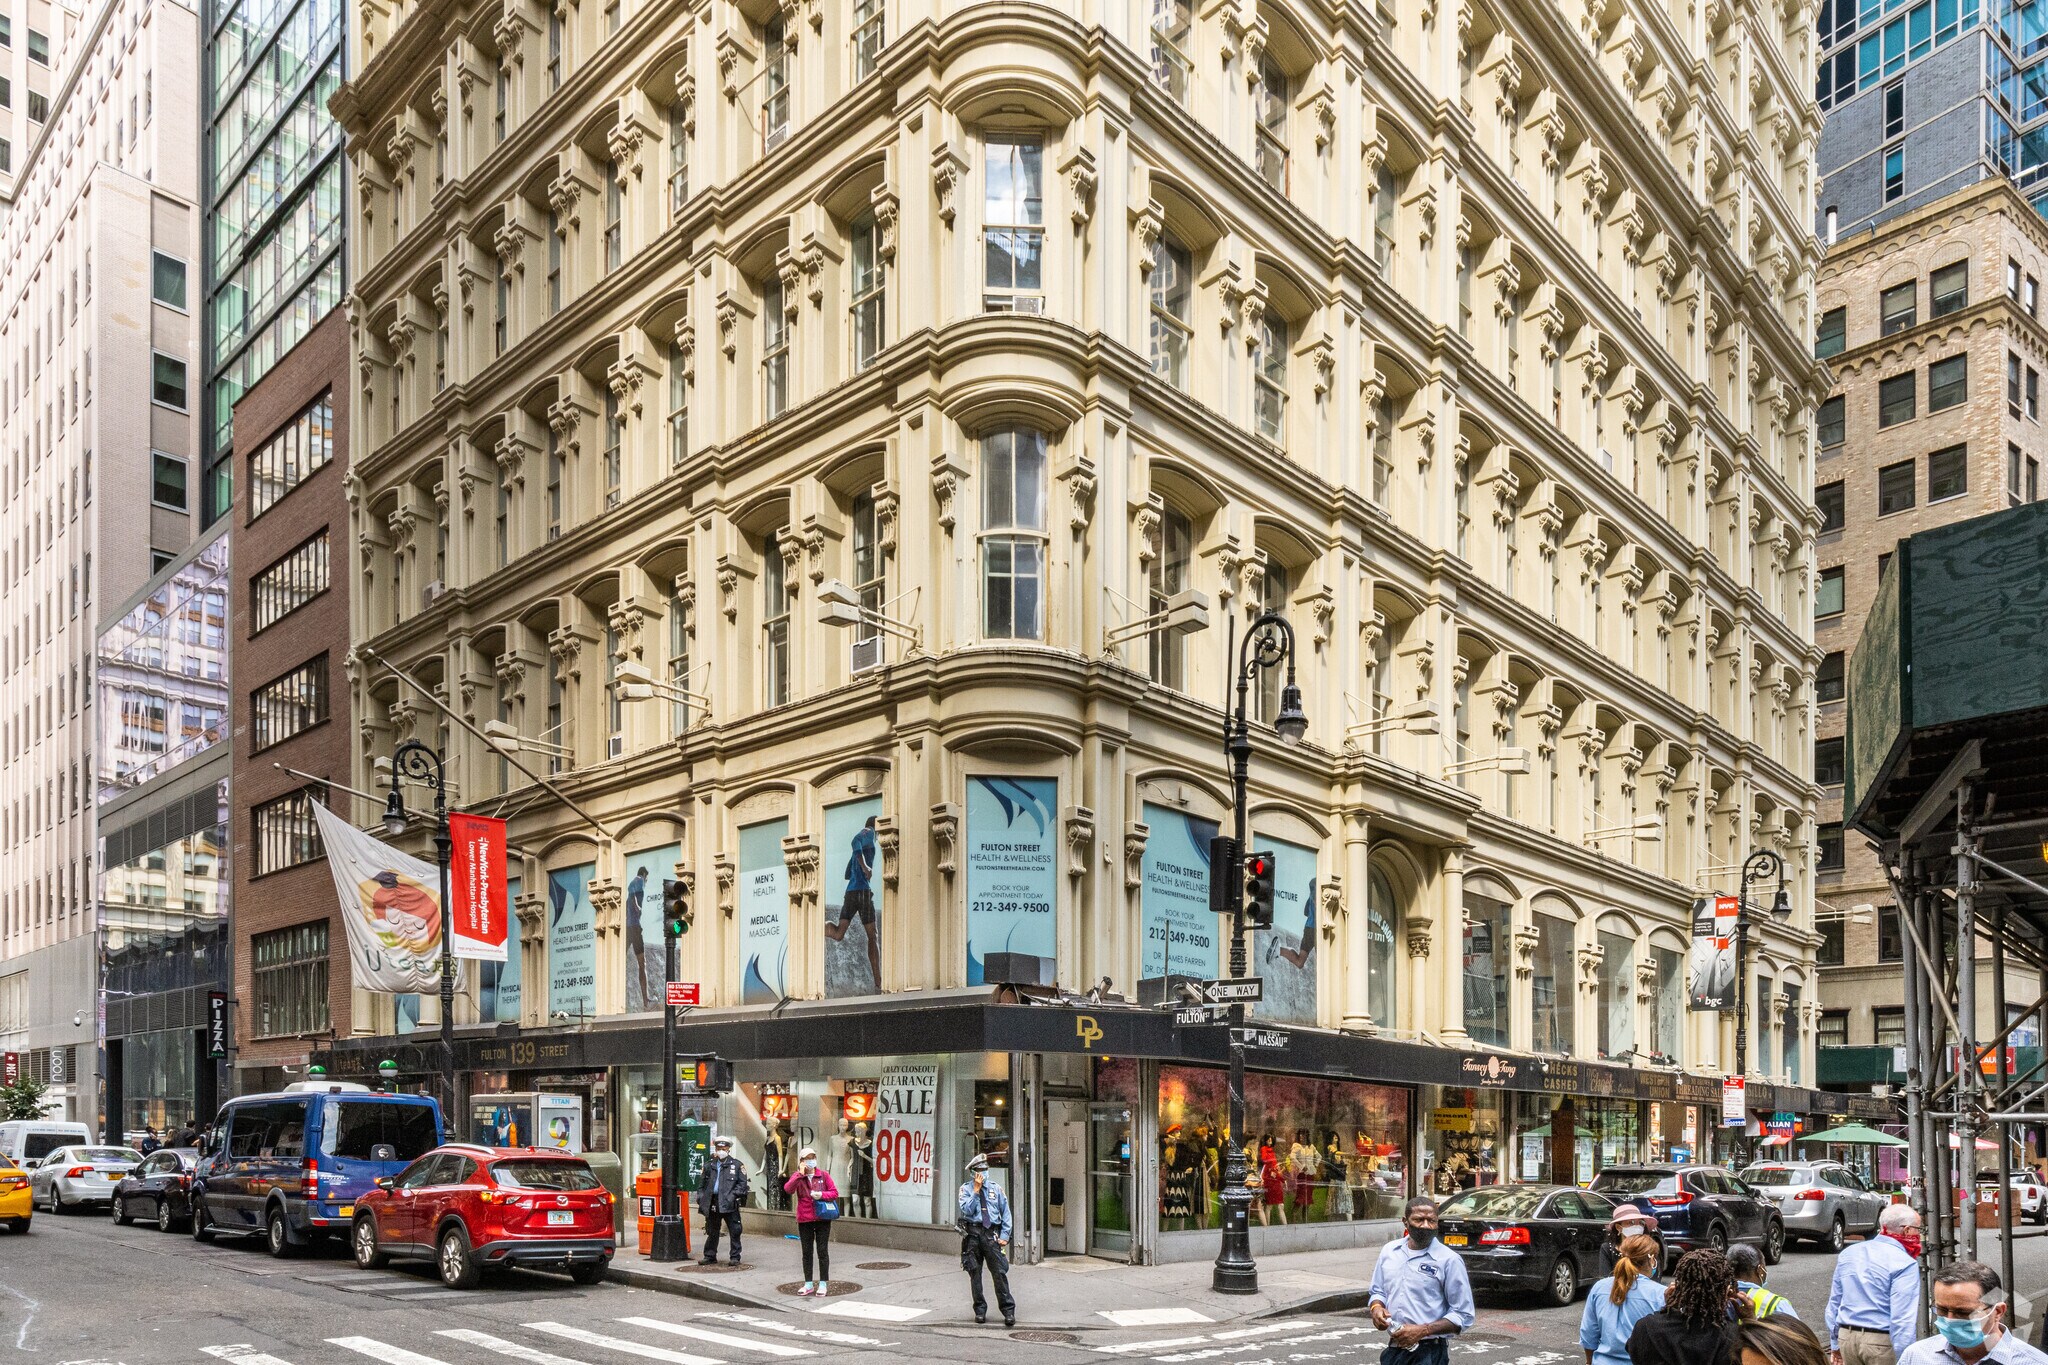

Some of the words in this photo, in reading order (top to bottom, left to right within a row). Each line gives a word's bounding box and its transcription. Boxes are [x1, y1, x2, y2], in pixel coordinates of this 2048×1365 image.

[981, 843, 1012, 852] FULTON
[1014, 844, 1041, 852] STREET
[970, 853, 1001, 862] HEALTH
[1156, 861, 1182, 875] FULTON
[1183, 867, 1203, 880] STREET
[754, 873, 775, 885] MEN'S
[1147, 872, 1173, 886] HEALTH
[479, 843, 489, 934] NewYork-Presbyterian
[753, 886, 776, 897] HEALTH
[1275, 889, 1298, 902] NCTURE
[972, 901, 1050, 913] 212-349-9500
[470, 901, 478, 929] Hospital
[750, 914, 779, 926] MEDICAL
[1165, 908, 1180, 917] BOOK
[1181, 912, 1195, 920] YOUR
[558, 926, 573, 934] FULTON
[575, 923, 589, 931] STREET
[1154, 916, 1189, 928] APPONTMENT
[1189, 922, 1205, 931] TODAY
[749, 926, 780, 939] MASSAGE
[1149, 926, 1210, 948] 212349-9500
[1166, 954, 1184, 964] AMES
[554, 975, 594, 990] 212-349-9500
[1211, 987, 1228, 997] ONE
[1236, 985, 1255, 996] WAY
[1705, 996, 1722, 1008] bgc
[1176, 1012, 1205, 1024] FULTON
[212, 998, 224, 1052] PIZZA
[1258, 1034, 1284, 1047] NASSAU
[480, 1048, 507, 1061] FULTON
[511, 1041, 536, 1065] 139
[540, 1044, 569, 1058] STREET
[52, 1050, 63, 1082] noon
[883, 1065, 901, 1074] CRAZY
[901, 1065, 937, 1074] CLOSEOUT
[1544, 1061, 1578, 1077] HECKS
[881, 1075, 935, 1087] CLEARANCE
[1543, 1078, 1578, 1091] CASHED
[762, 1097, 798, 1118] SAL
[878, 1088, 933, 1115] SALE
[887, 1119, 894, 1128] UP
[894, 1119, 901, 1129] TO
[1676, 1155, 1683, 1163] P
[912, 1167, 930, 1184] OFF
